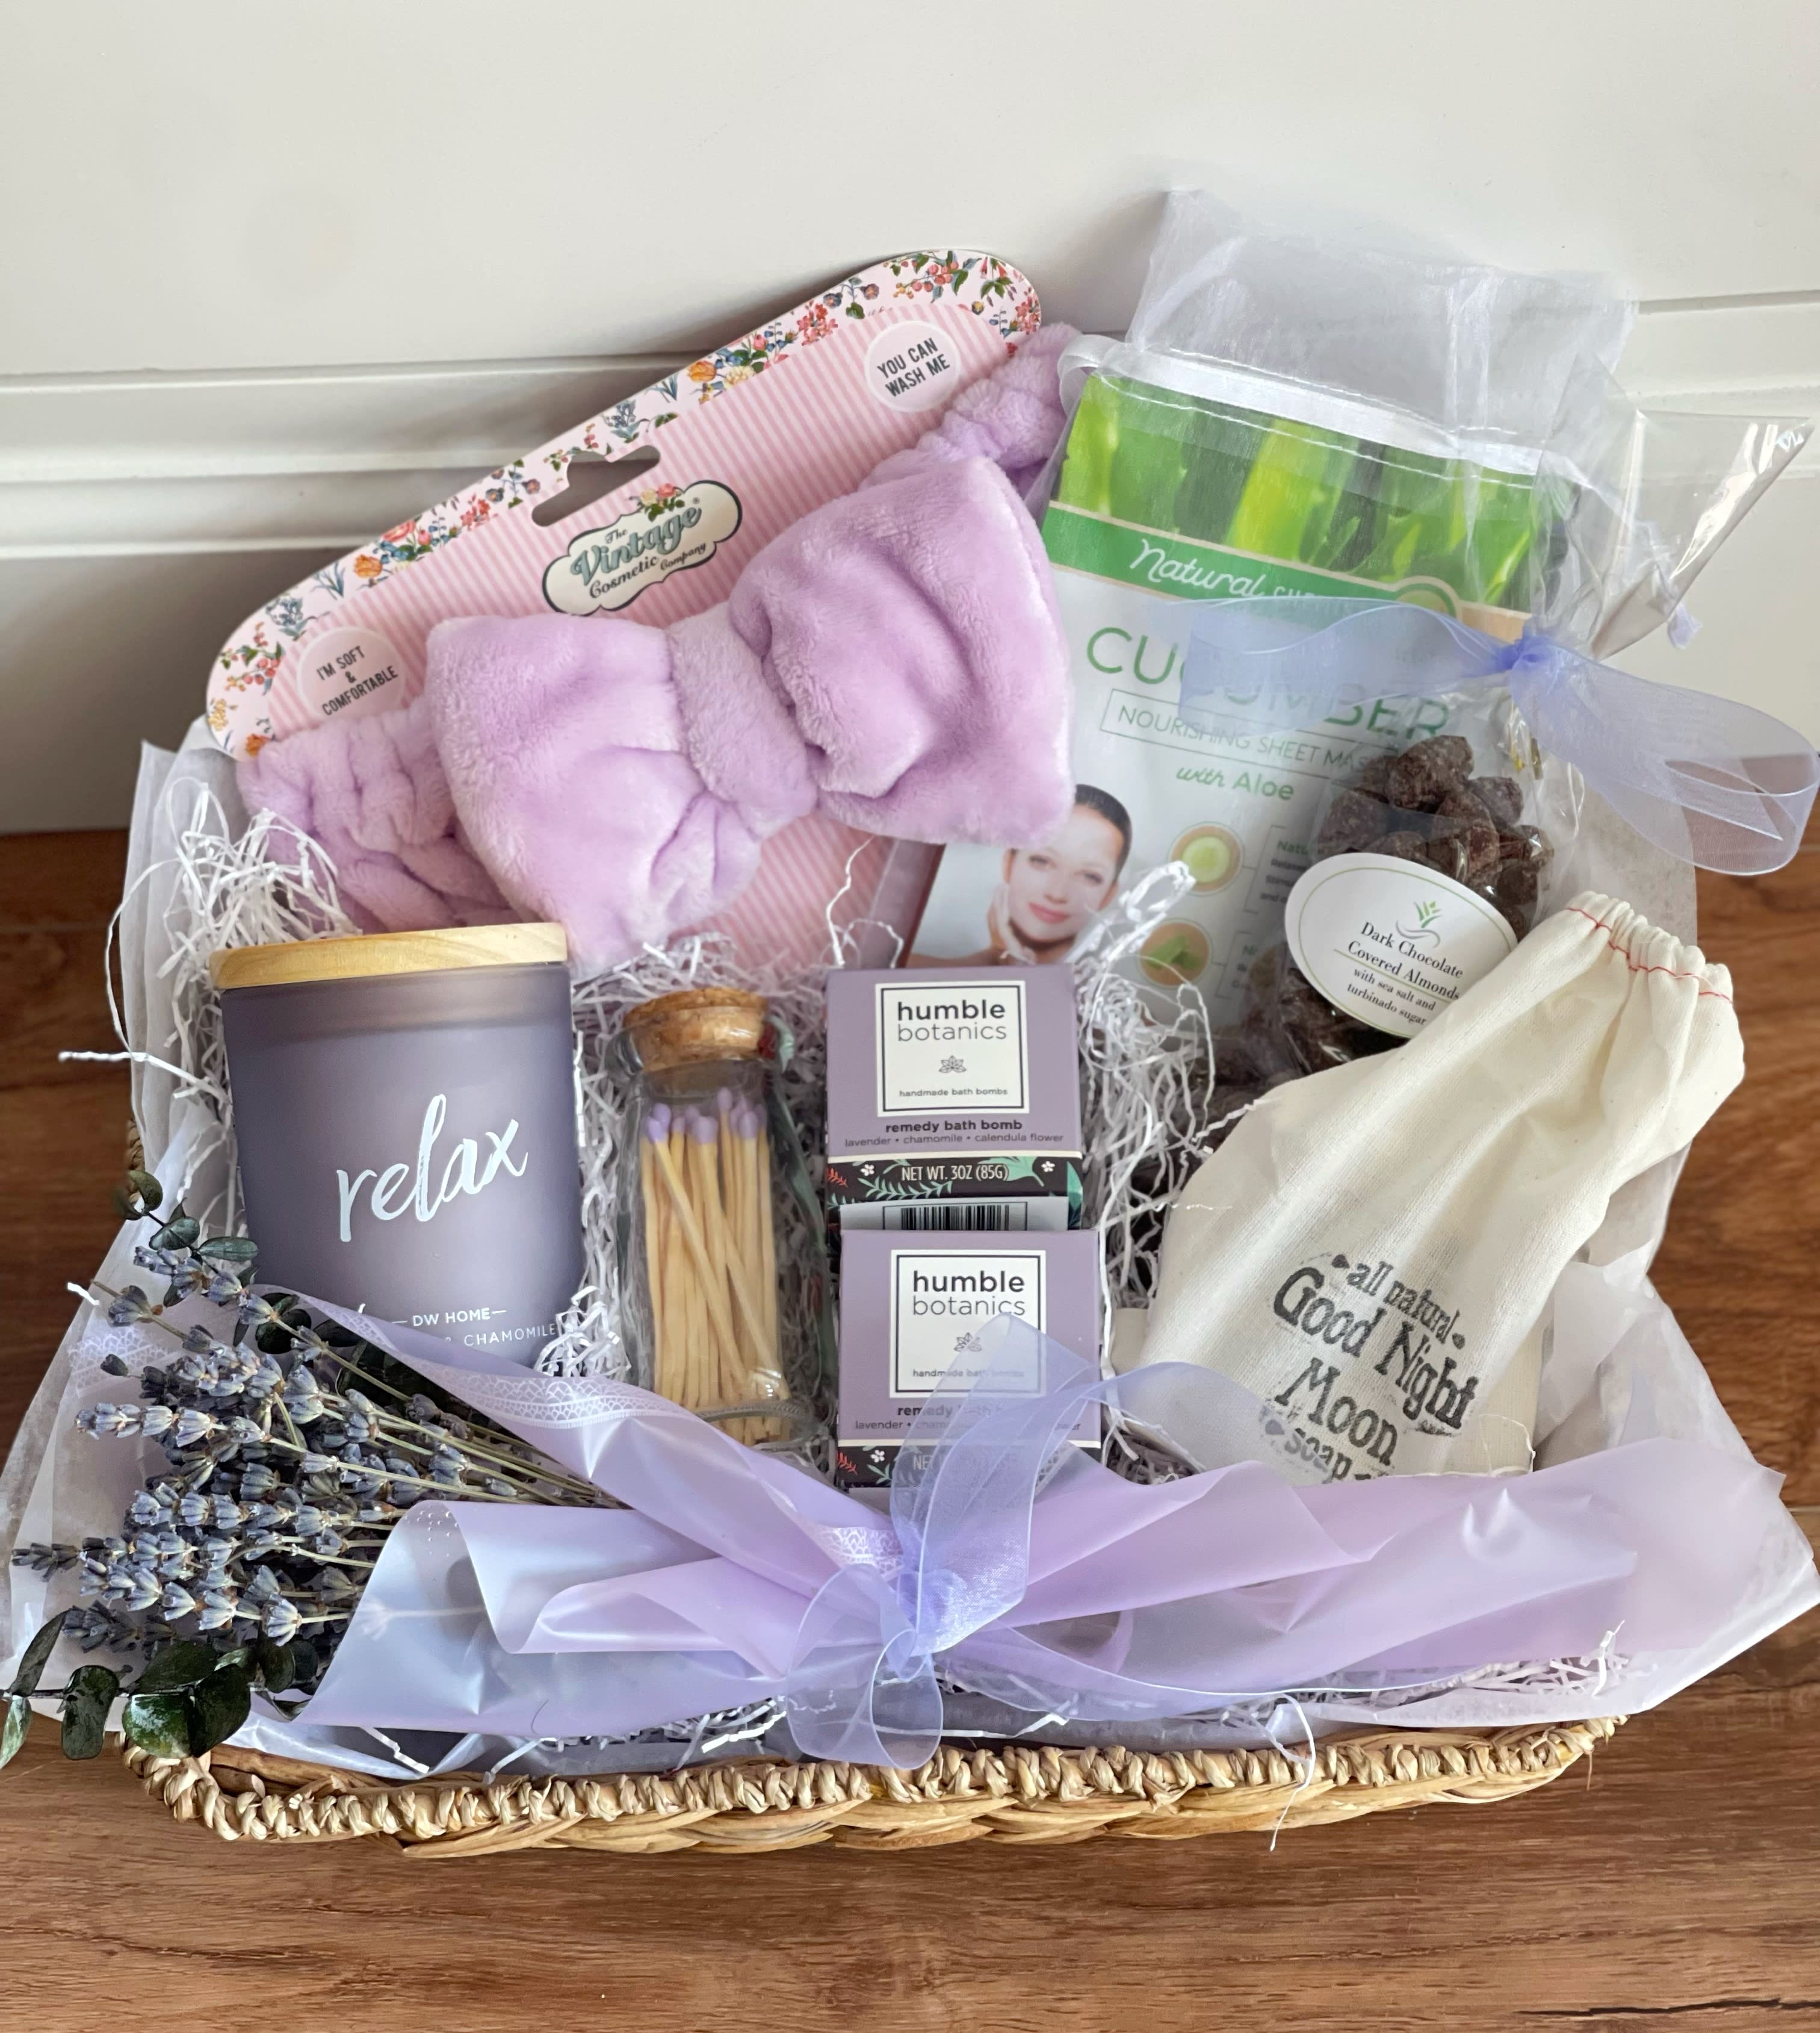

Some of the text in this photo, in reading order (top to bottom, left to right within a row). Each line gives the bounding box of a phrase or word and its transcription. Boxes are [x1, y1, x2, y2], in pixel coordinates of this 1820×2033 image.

[877, 338, 938, 379] YOU CAN
[885, 353, 950, 397] WASH ME
[570, 507, 702, 586] Vintage
[605, 529, 627, 544] The
[589, 542, 707, 598] Cosmetic Company
[317, 645, 365, 680] I'M SOFT
[345, 671, 356, 683] &
[322, 665, 398, 715] COMFORTABLE
[1118, 704, 1251, 751] NOURISHING
[1257, 736, 1320, 765] SHEET
[1176, 765, 1294, 801] with Aloe
[1360, 921, 1463, 979] Dark Chocolate
[1348, 941, 1460, 1001] Covered Almonds
[1347, 982, 1428, 1026] turbinado sugar
[1354, 968, 1436, 1011] with sea salt and
[898, 999, 1006, 1021] humble
[898, 1023, 1007, 1042] botanics
[899, 1089, 949, 1097] handmade
[845, 1132, 1064, 1147] lavender chamomile calendula flower
[885, 1119, 1023, 1133] remedy bath bomb
[336, 1094, 529, 1243] relax
[901, 1165, 924, 1181] NET
[926, 1165, 948, 1181] WT.
[975, 1163, 1011, 1181] (85G)
[913, 1270, 1025, 1292] humble
[412, 1307, 491, 1327] DW HOME
[912, 1296, 1026, 1316] botanics
[1346, 1260, 1461, 1345] all natural
[463, 1323, 556, 1347] CHAMOMILE
[1272, 1266, 1480, 1430] Good Night
[912, 1369, 963, 1378] handmade
[855, 1420, 902, 1430] lavender
[897, 1406, 952, 1418] remedy
[1274, 1357, 1398, 1467] Moon
[1284, 1427, 1353, 1485] soap
